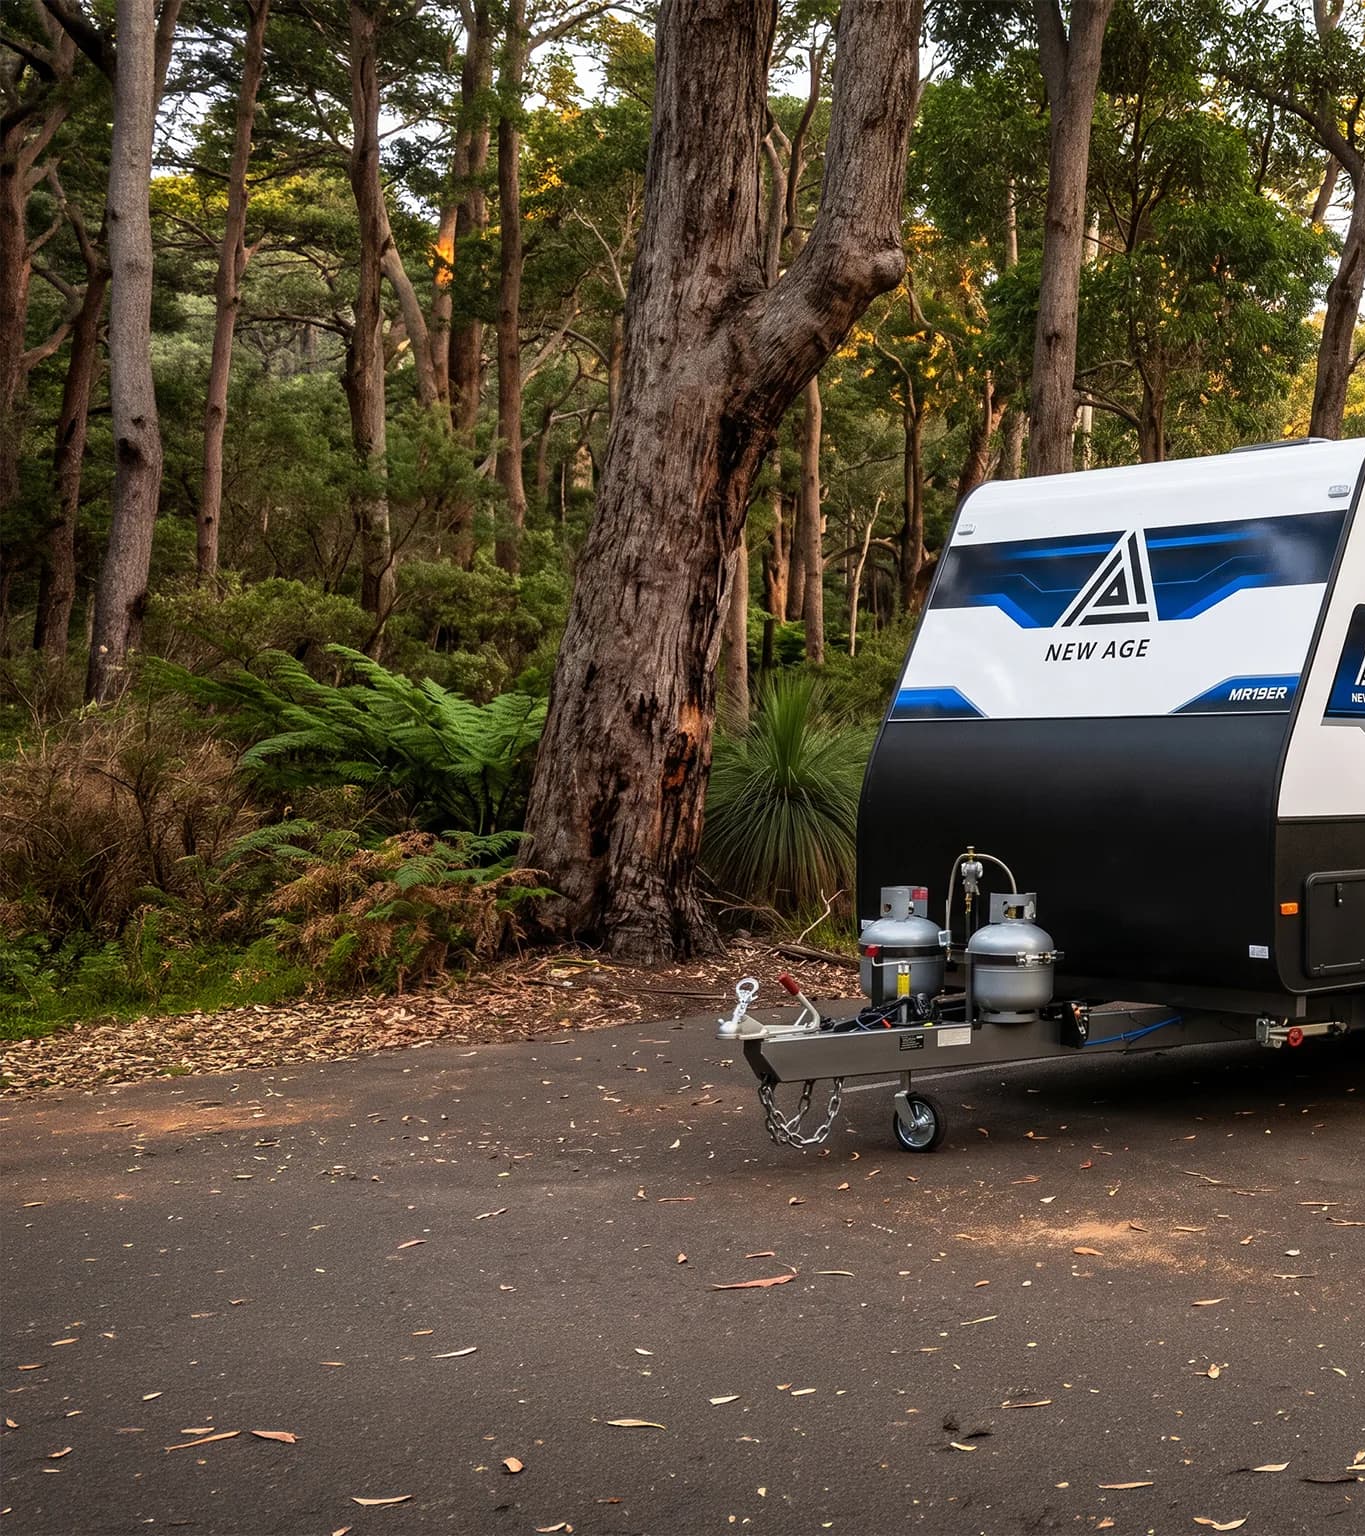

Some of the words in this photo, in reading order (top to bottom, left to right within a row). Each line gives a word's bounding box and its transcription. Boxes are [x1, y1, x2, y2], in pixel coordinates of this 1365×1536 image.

[1045, 641, 1098, 662] NEW
[1101, 639, 1151, 660] AGE
[1228, 686, 1288, 701] MR19ER
